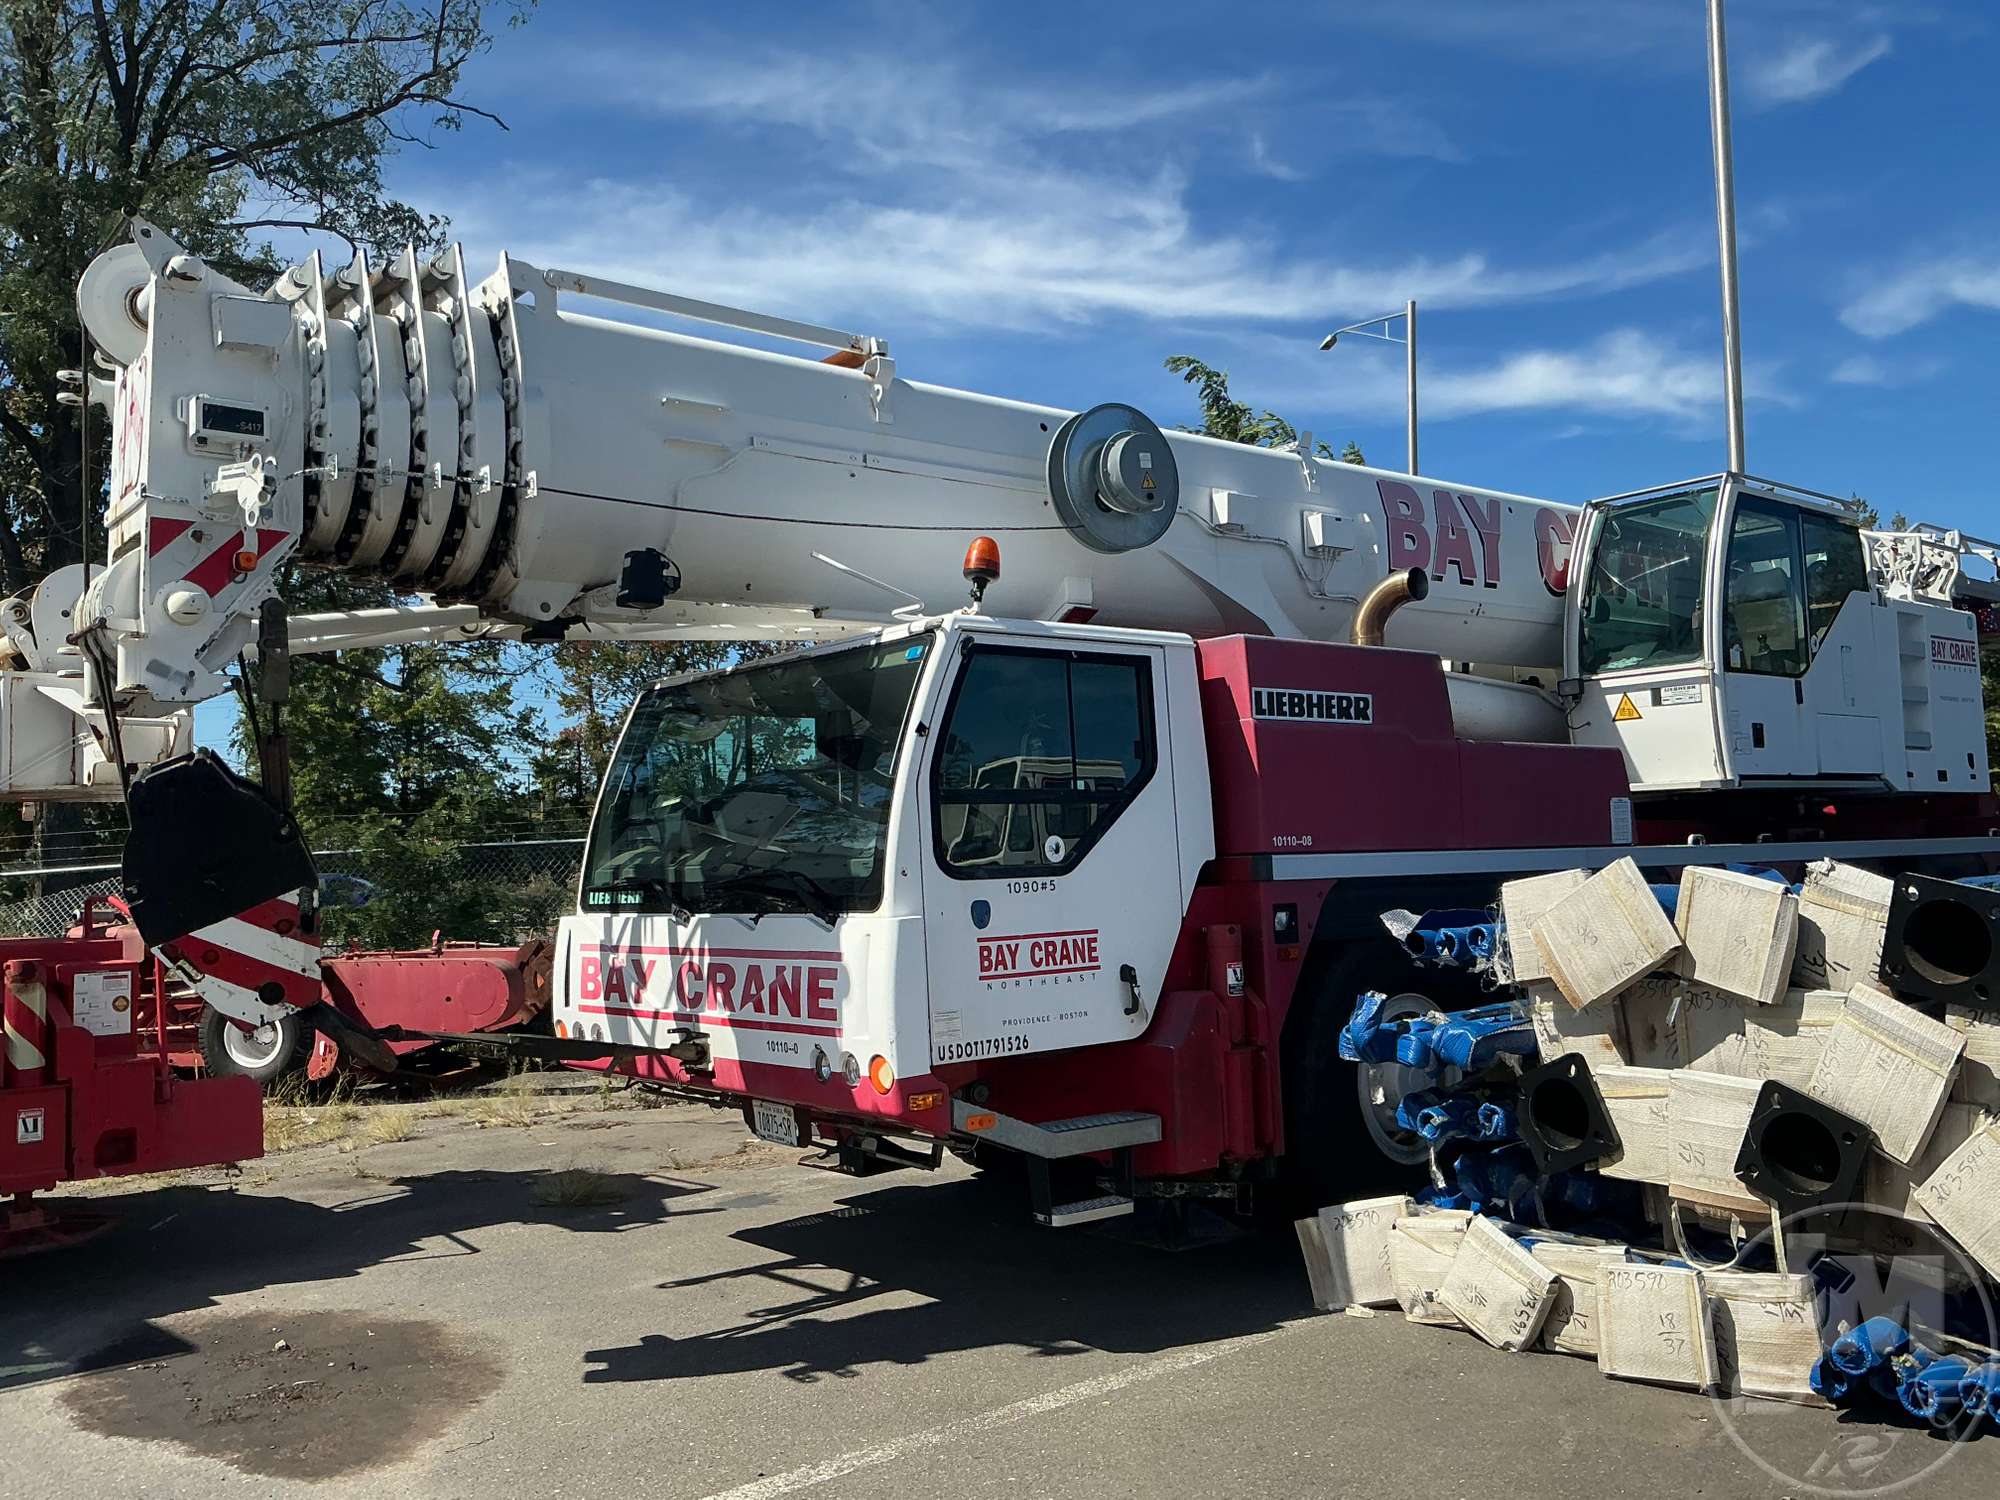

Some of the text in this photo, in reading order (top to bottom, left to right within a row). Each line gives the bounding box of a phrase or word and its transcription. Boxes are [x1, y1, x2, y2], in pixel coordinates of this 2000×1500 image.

[1376, 479, 1501, 590] BAY
[1931, 639, 1977, 663] BAY CRANE
[1253, 690, 1371, 721] LIEBHERR
[1007, 879, 1056, 894] 1090#5
[978, 936, 1100, 973] BAY CRANE
[580, 956, 838, 1022] BAY CRANE
[986, 972, 1097, 991] NORTHEAST
[1002, 1015, 1051, 1027] PROVIDENCE
[1059, 1010, 1089, 1021] BOSTON
[938, 1034, 1030, 1062] USDOT1791526
